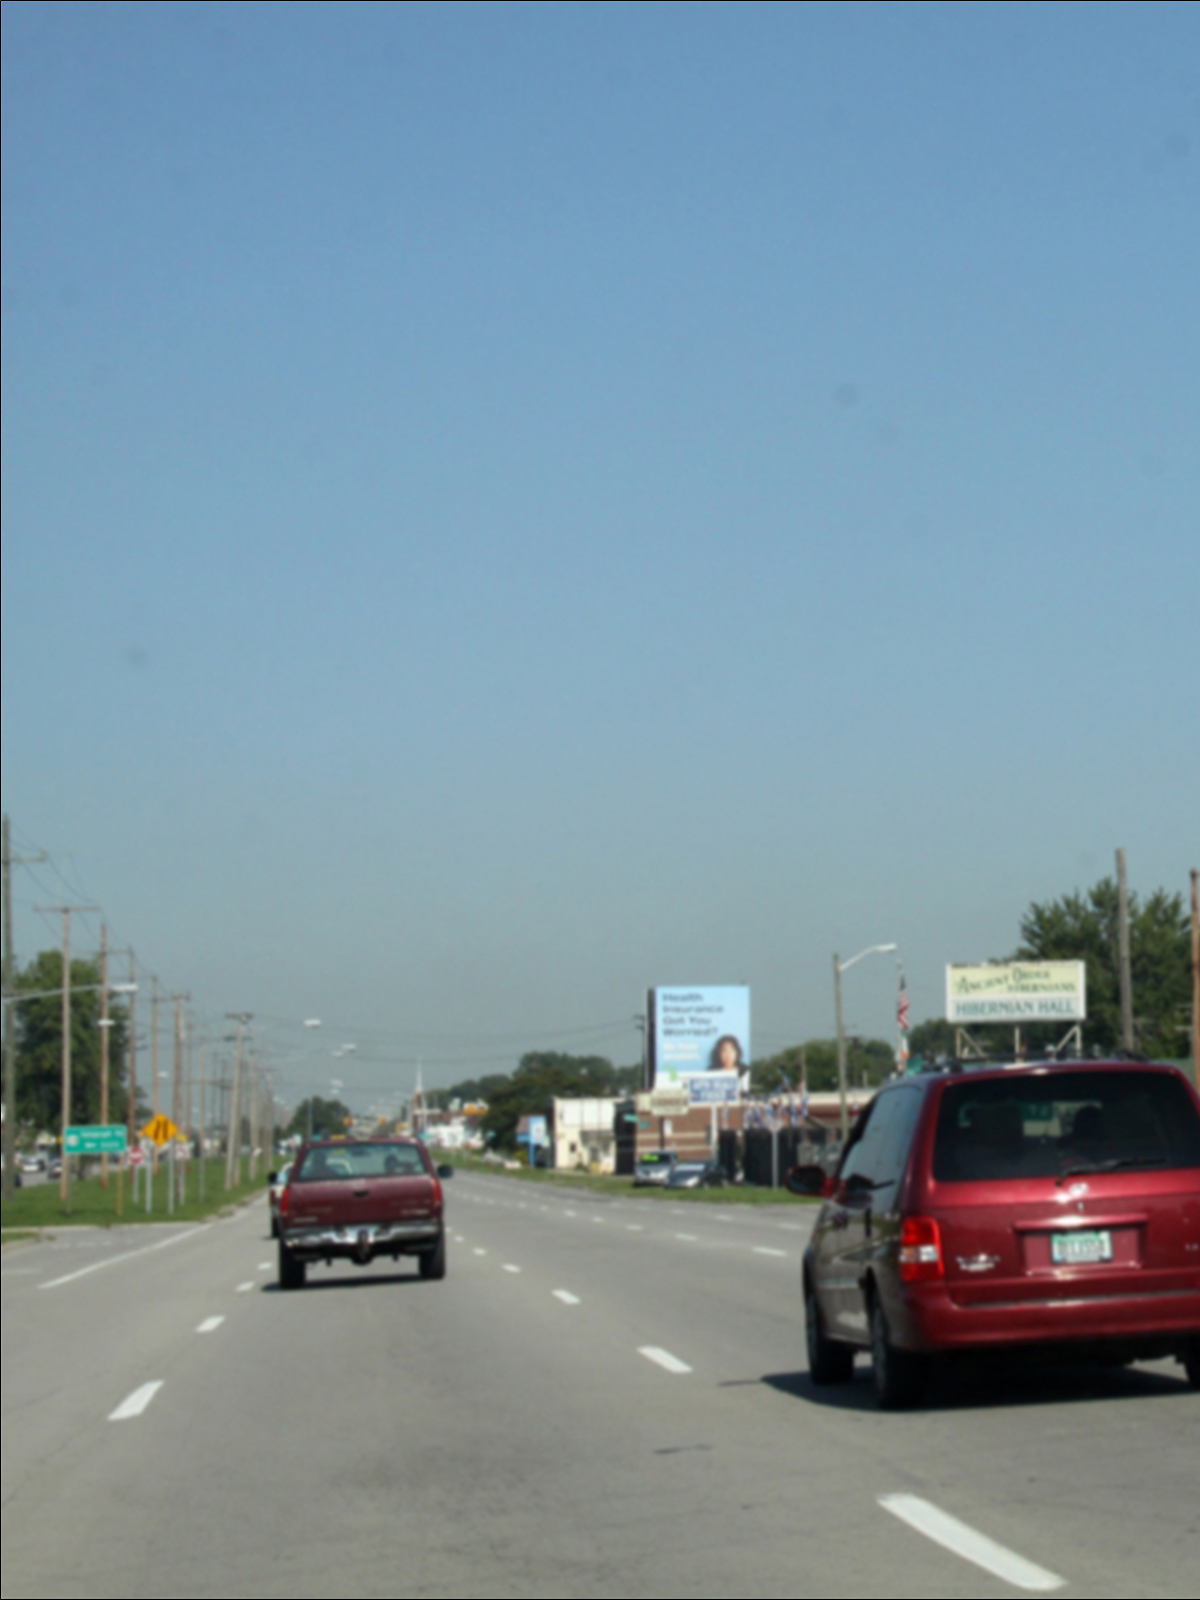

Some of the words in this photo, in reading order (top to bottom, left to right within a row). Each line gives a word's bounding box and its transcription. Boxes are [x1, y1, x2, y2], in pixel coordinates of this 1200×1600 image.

[662, 992, 704, 1002] Health
[662, 1004, 725, 1014] Insurance
[955, 1001, 1034, 1016] HIBERNIAN
[1037, 998, 1074, 1014] HALL
[662, 1015, 685, 1025] Got
[689, 1015, 712, 1025] You
[662, 1026, 719, 1037] Worried?
